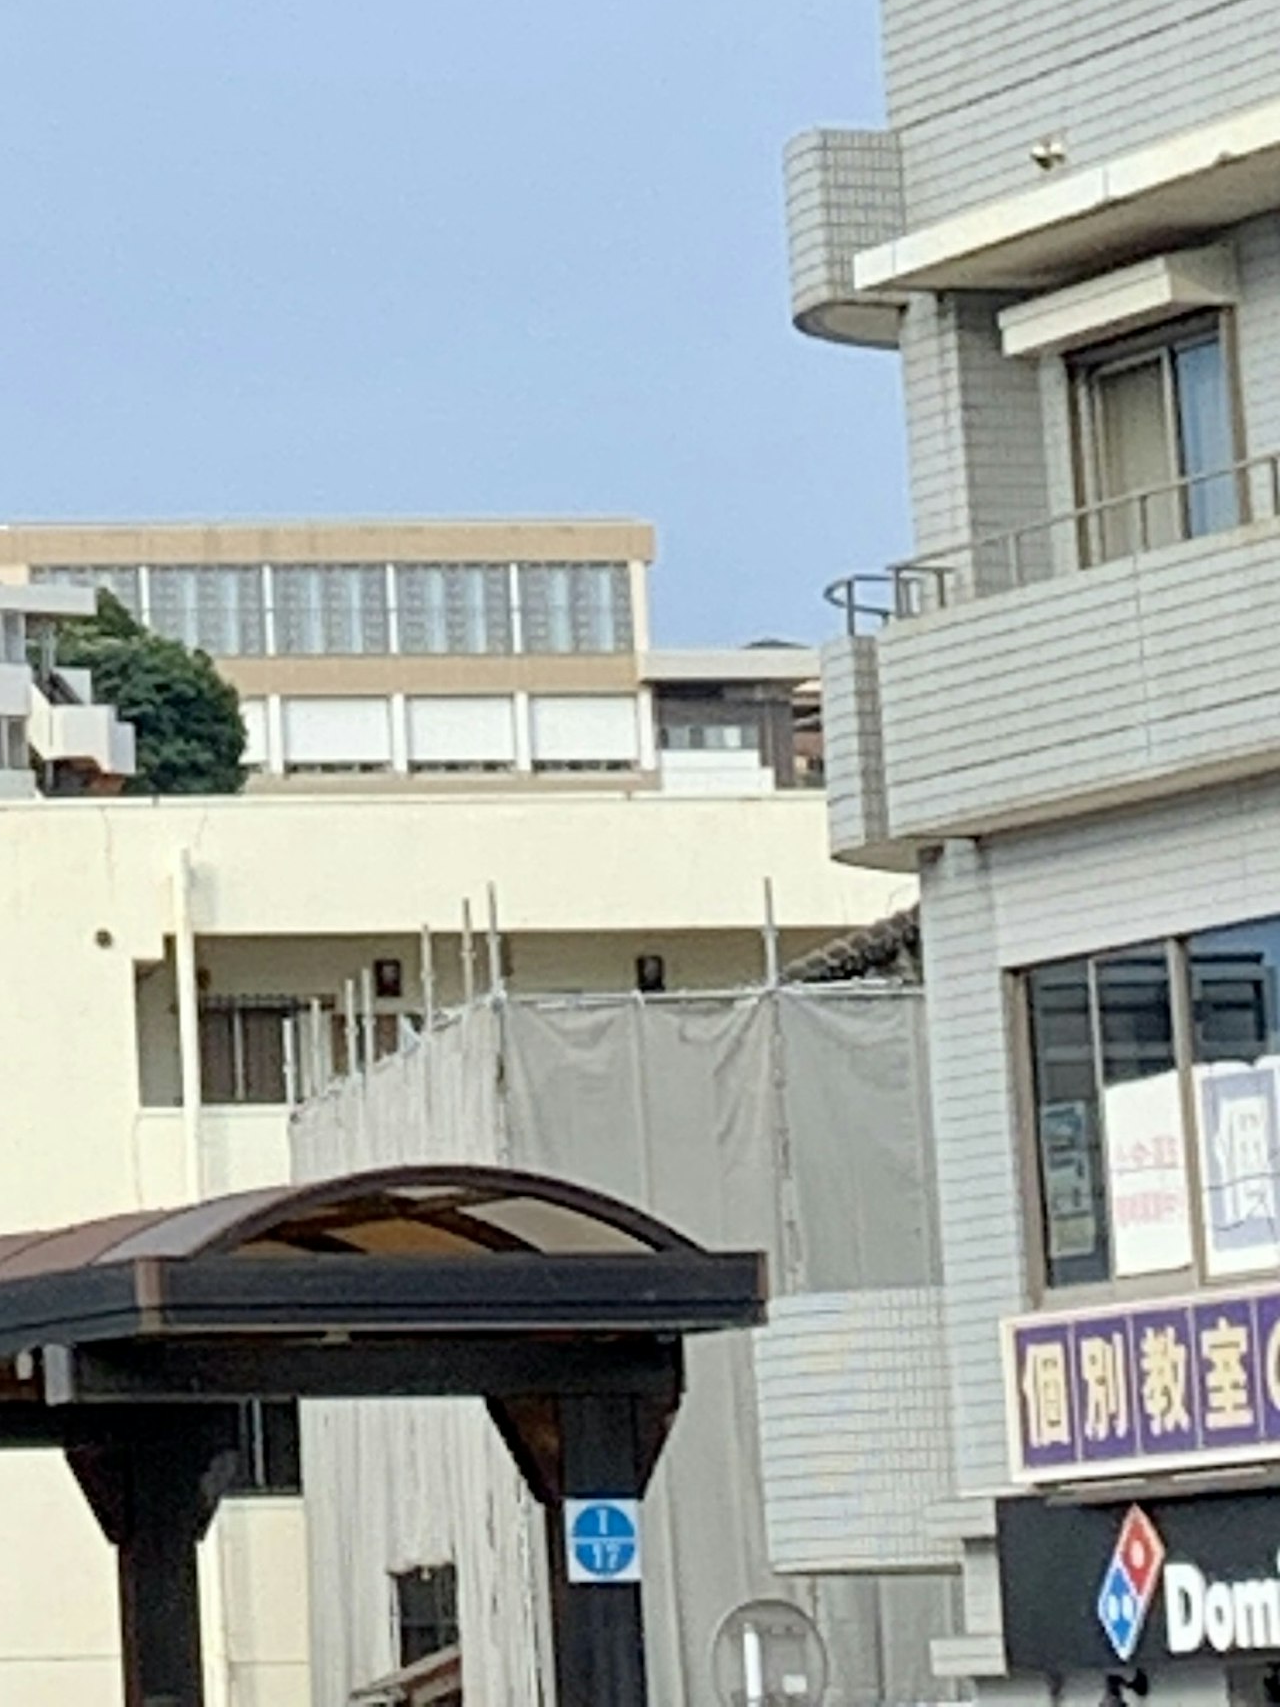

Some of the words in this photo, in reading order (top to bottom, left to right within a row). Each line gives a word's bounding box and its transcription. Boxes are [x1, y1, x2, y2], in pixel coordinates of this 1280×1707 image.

[1023, 1316, 1280, 1448] 個別教室
[1164, 1546, 1280, 1653] Dom
